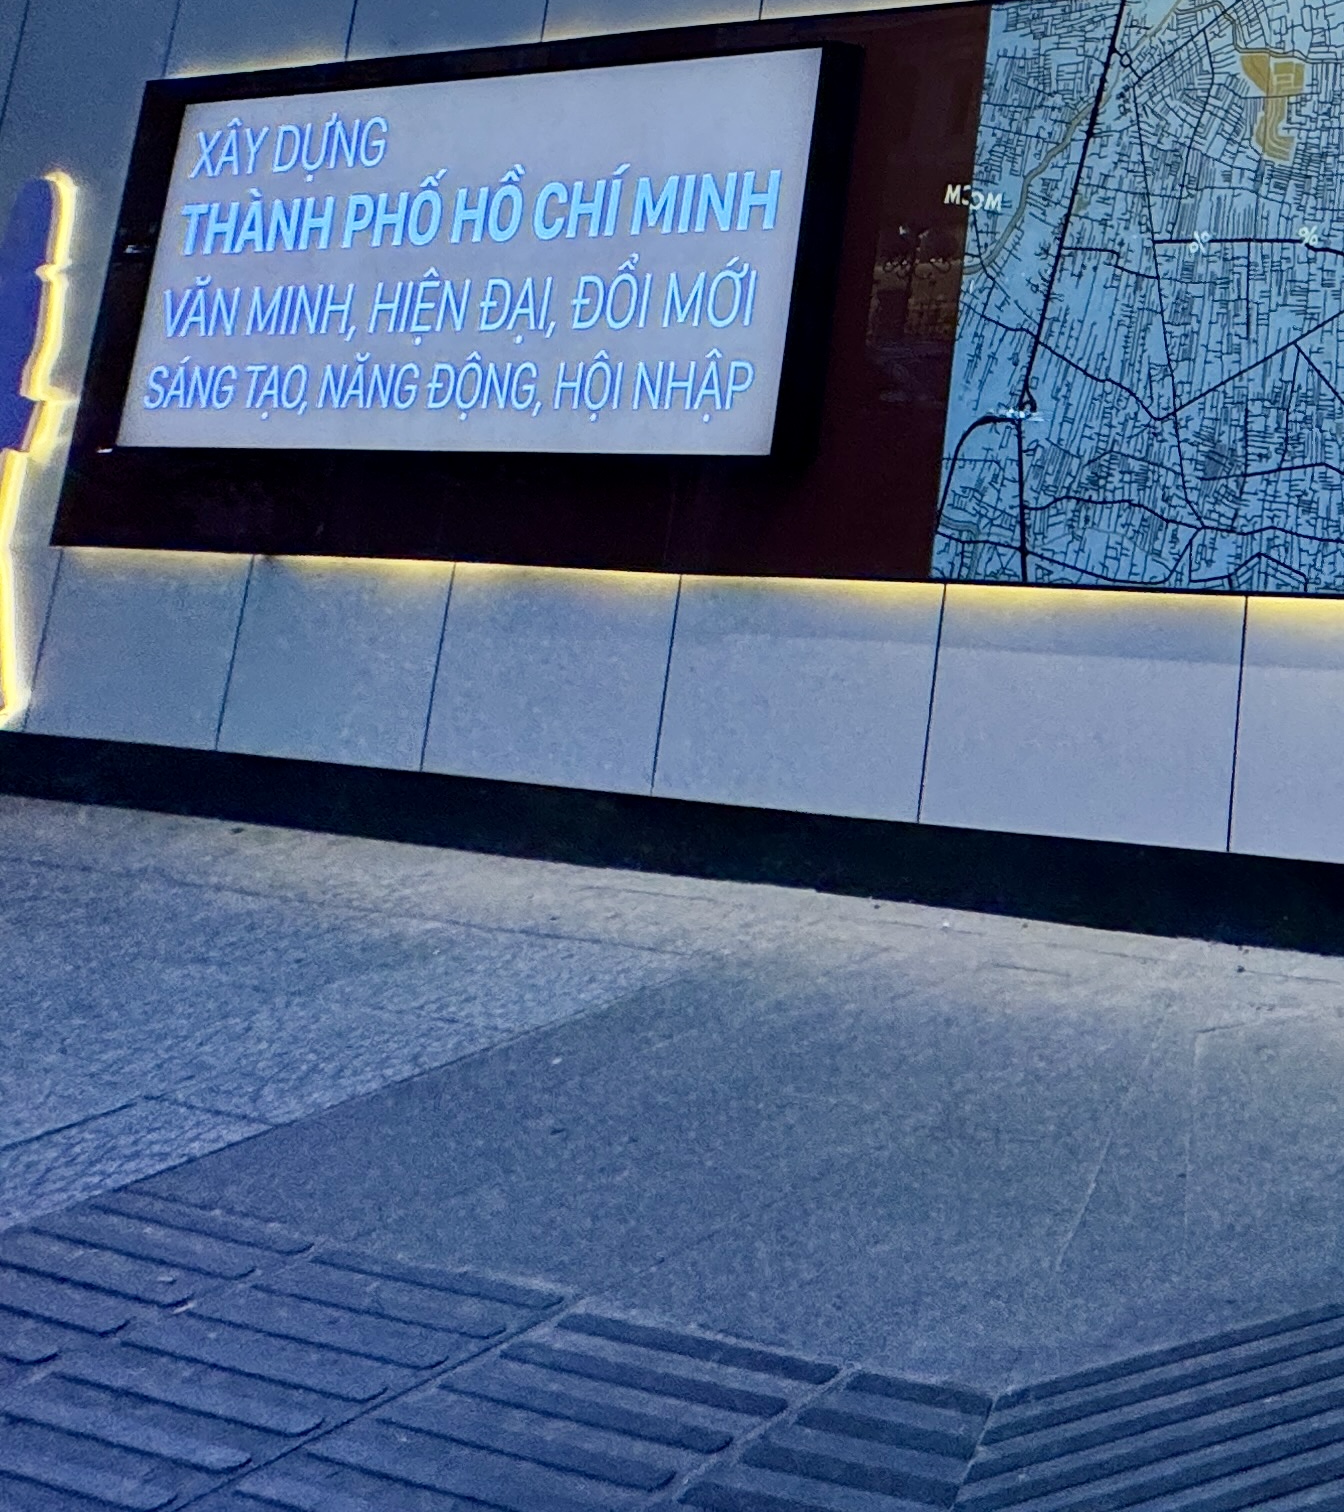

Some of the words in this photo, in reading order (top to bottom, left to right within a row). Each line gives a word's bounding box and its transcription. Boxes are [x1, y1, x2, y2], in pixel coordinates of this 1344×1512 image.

[189, 117, 269, 178] XÂY
[272, 113, 388, 182] DỰNG
[181, 188, 335, 255] THÀNH
[341, 169, 447, 247] PHỐ
[450, 164, 525, 243] HỒ
[533, 163, 630, 240] CHÍ
[630, 169, 781, 235] MINH
[163, 275, 241, 338] VĂN
[244, 283, 357, 341] MINH,
[368, 267, 471, 345] HIỆN
[478, 276, 556, 344] ĐẠI,
[571, 252, 651, 330] ĐỔI
[662, 256, 756, 327] MỚI
[143, 355, 237, 409] SÁNG
[245, 364, 308, 420] TẠO,
[318, 352, 419, 409] NĂNG
[426, 351, 541, 421] ĐỘNG,
[553, 350, 625, 421] HỘI
[632, 348, 755, 422] NHẬP
